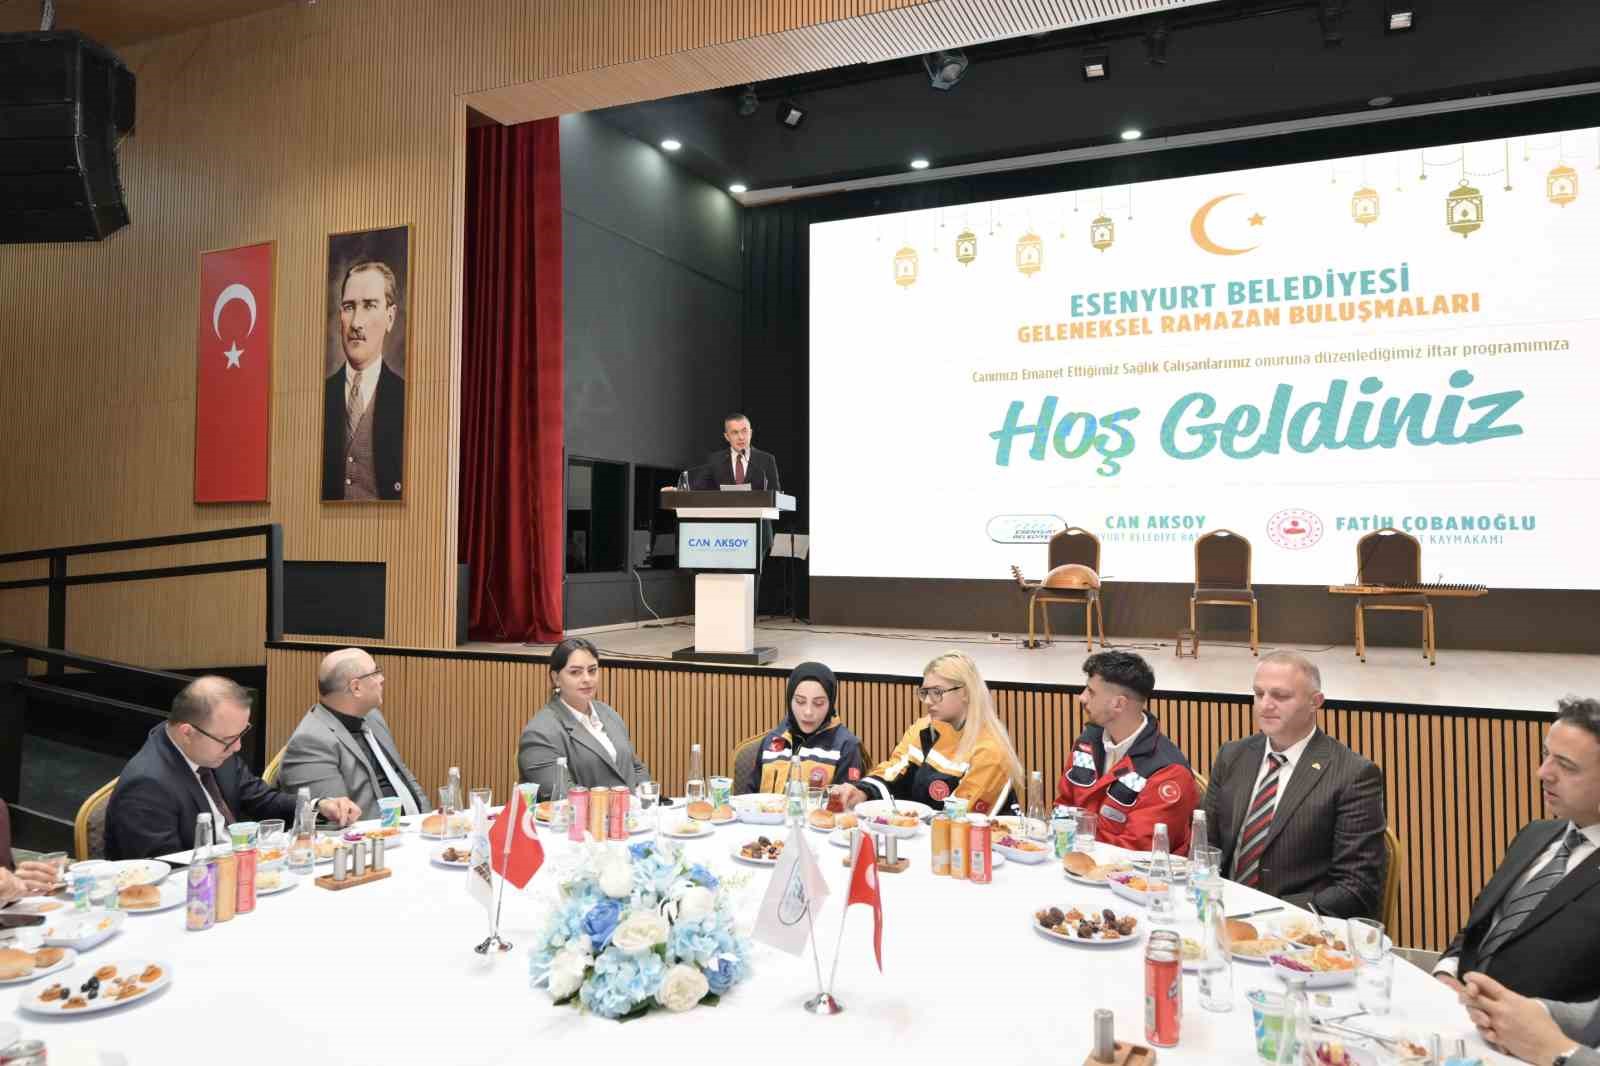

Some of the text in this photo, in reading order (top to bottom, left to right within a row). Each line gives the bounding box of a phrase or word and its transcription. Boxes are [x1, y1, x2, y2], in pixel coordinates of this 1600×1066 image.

[1070, 262, 1410, 317] ESENYURT BELEDİYESİ
[1017, 292, 1480, 343] GELENEKSEL RAMAZAN BULUŞMALARI
[1022, 367, 1063, 381] Emanet
[1123, 360, 1159, 376] Sağlık
[1255, 354, 1311, 368] onuruna
[1427, 343, 1457, 358] iftar
[1463, 338, 1570, 358] programımıza
[989, 369, 1524, 477] Hoş Geldiniz
[1105, 515, 1206, 529] CAN AKSOY
[1336, 512, 1536, 533] FATİH ÇOBANOĞLU
[688, 537, 749, 548] CAN AKSOY
[1430, 533, 1503, 545] KAYMAKAMI
